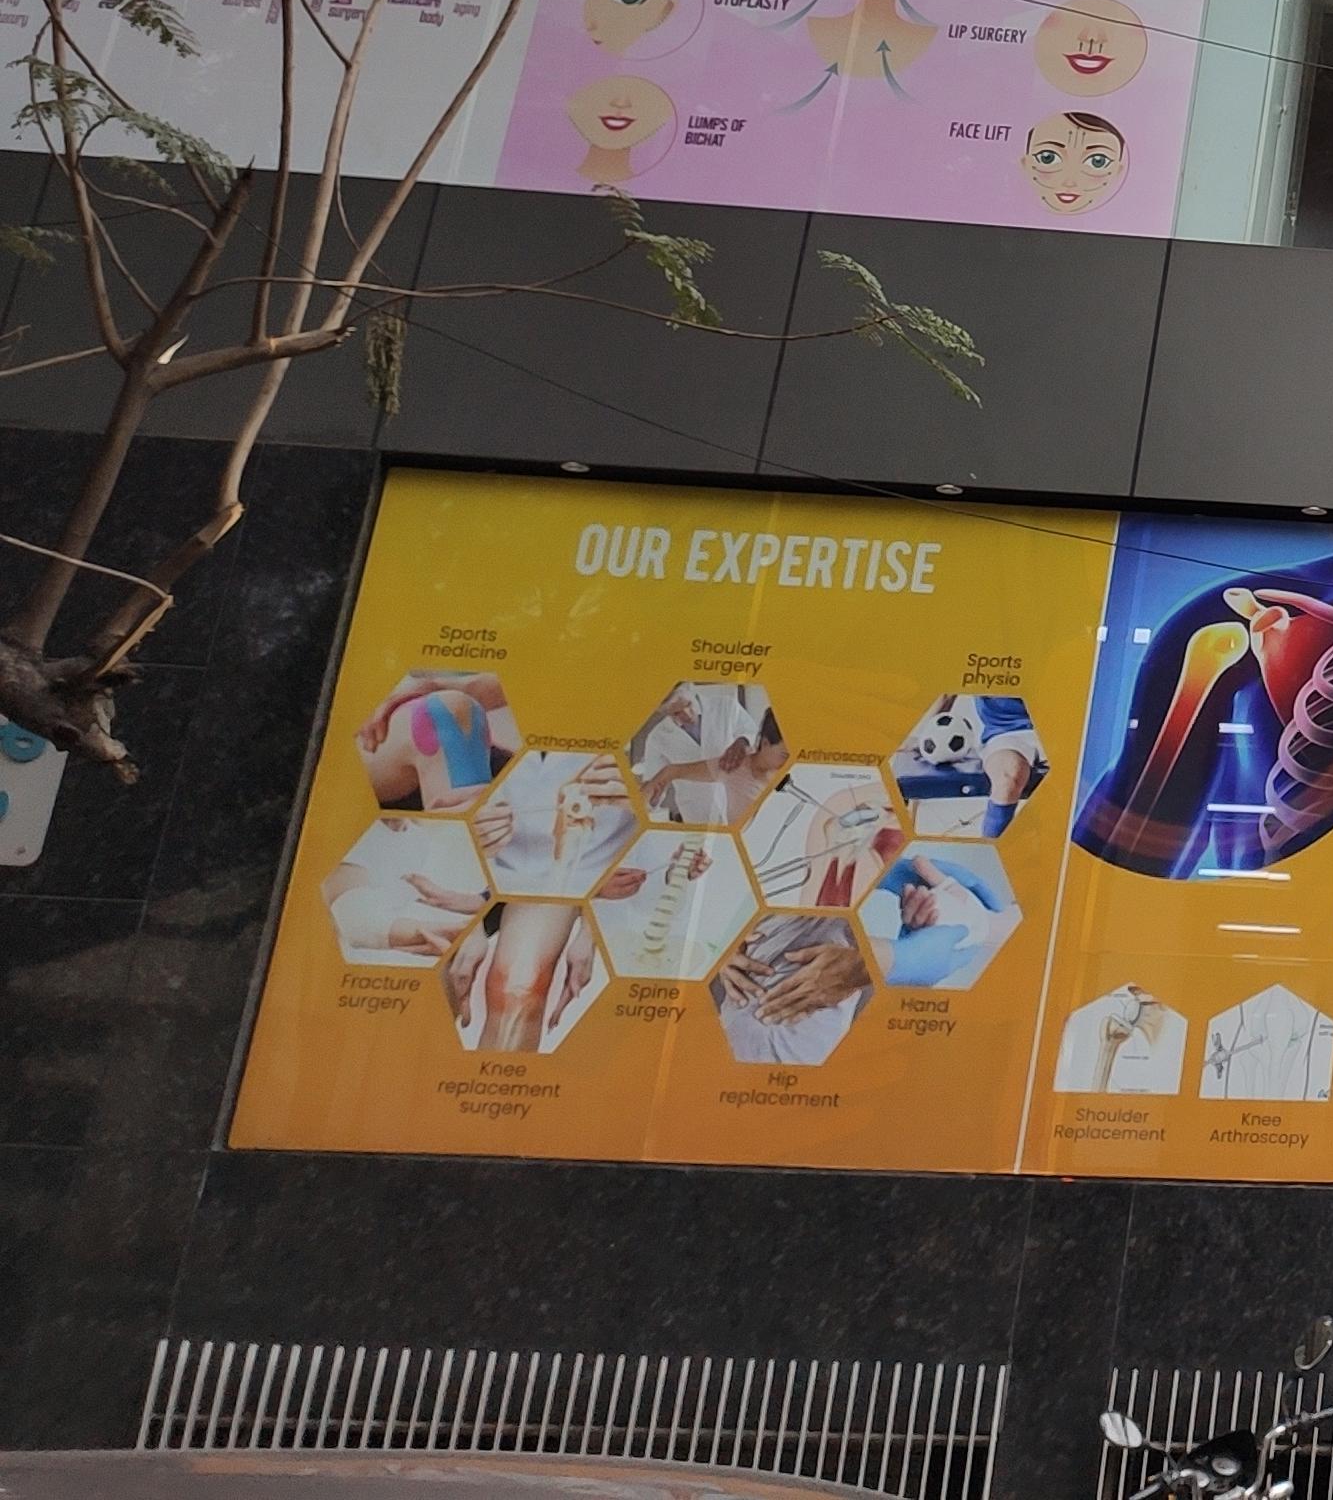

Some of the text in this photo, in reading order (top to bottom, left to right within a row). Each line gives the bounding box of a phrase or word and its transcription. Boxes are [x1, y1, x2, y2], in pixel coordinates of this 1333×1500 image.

[947, 23, 1028, 45] LIP SURGERY
[688, 114, 747, 133] LUMPS OF
[948, 121, 1012, 142] FACE LIFT
[575, 523, 943, 594] OUR EXPERTISE
[438, 624, 498, 648] Sports
[421, 639, 508, 662] medicine
[690, 638, 773, 659] Shoulder
[692, 656, 764, 679] surgery
[966, 652, 1023, 676] Sports
[962, 668, 1022, 690] physio
[797, 748, 887, 767] Arthroscopy
[341, 973, 421, 994] Fracture
[628, 983, 680, 1004] Spine
[337, 994, 412, 1015] surgery
[615, 1003, 686, 1024] surgery
[900, 997, 950, 1015] Hand
[888, 1016, 956, 1037] surgery
[479, 1060, 527, 1078] Knee
[437, 1078, 561, 1100] replacement
[768, 1071, 798, 1090] Hip
[719, 1089, 840, 1109] replacement
[458, 1100, 532, 1120] surgery
[1075, 1106, 1149, 1126] Shoulder
[1241, 1111, 1282, 1129] Knee
[1054, 1124, 1166, 1144] Replacement
[1209, 1129, 1310, 1150] Arthroscopy
